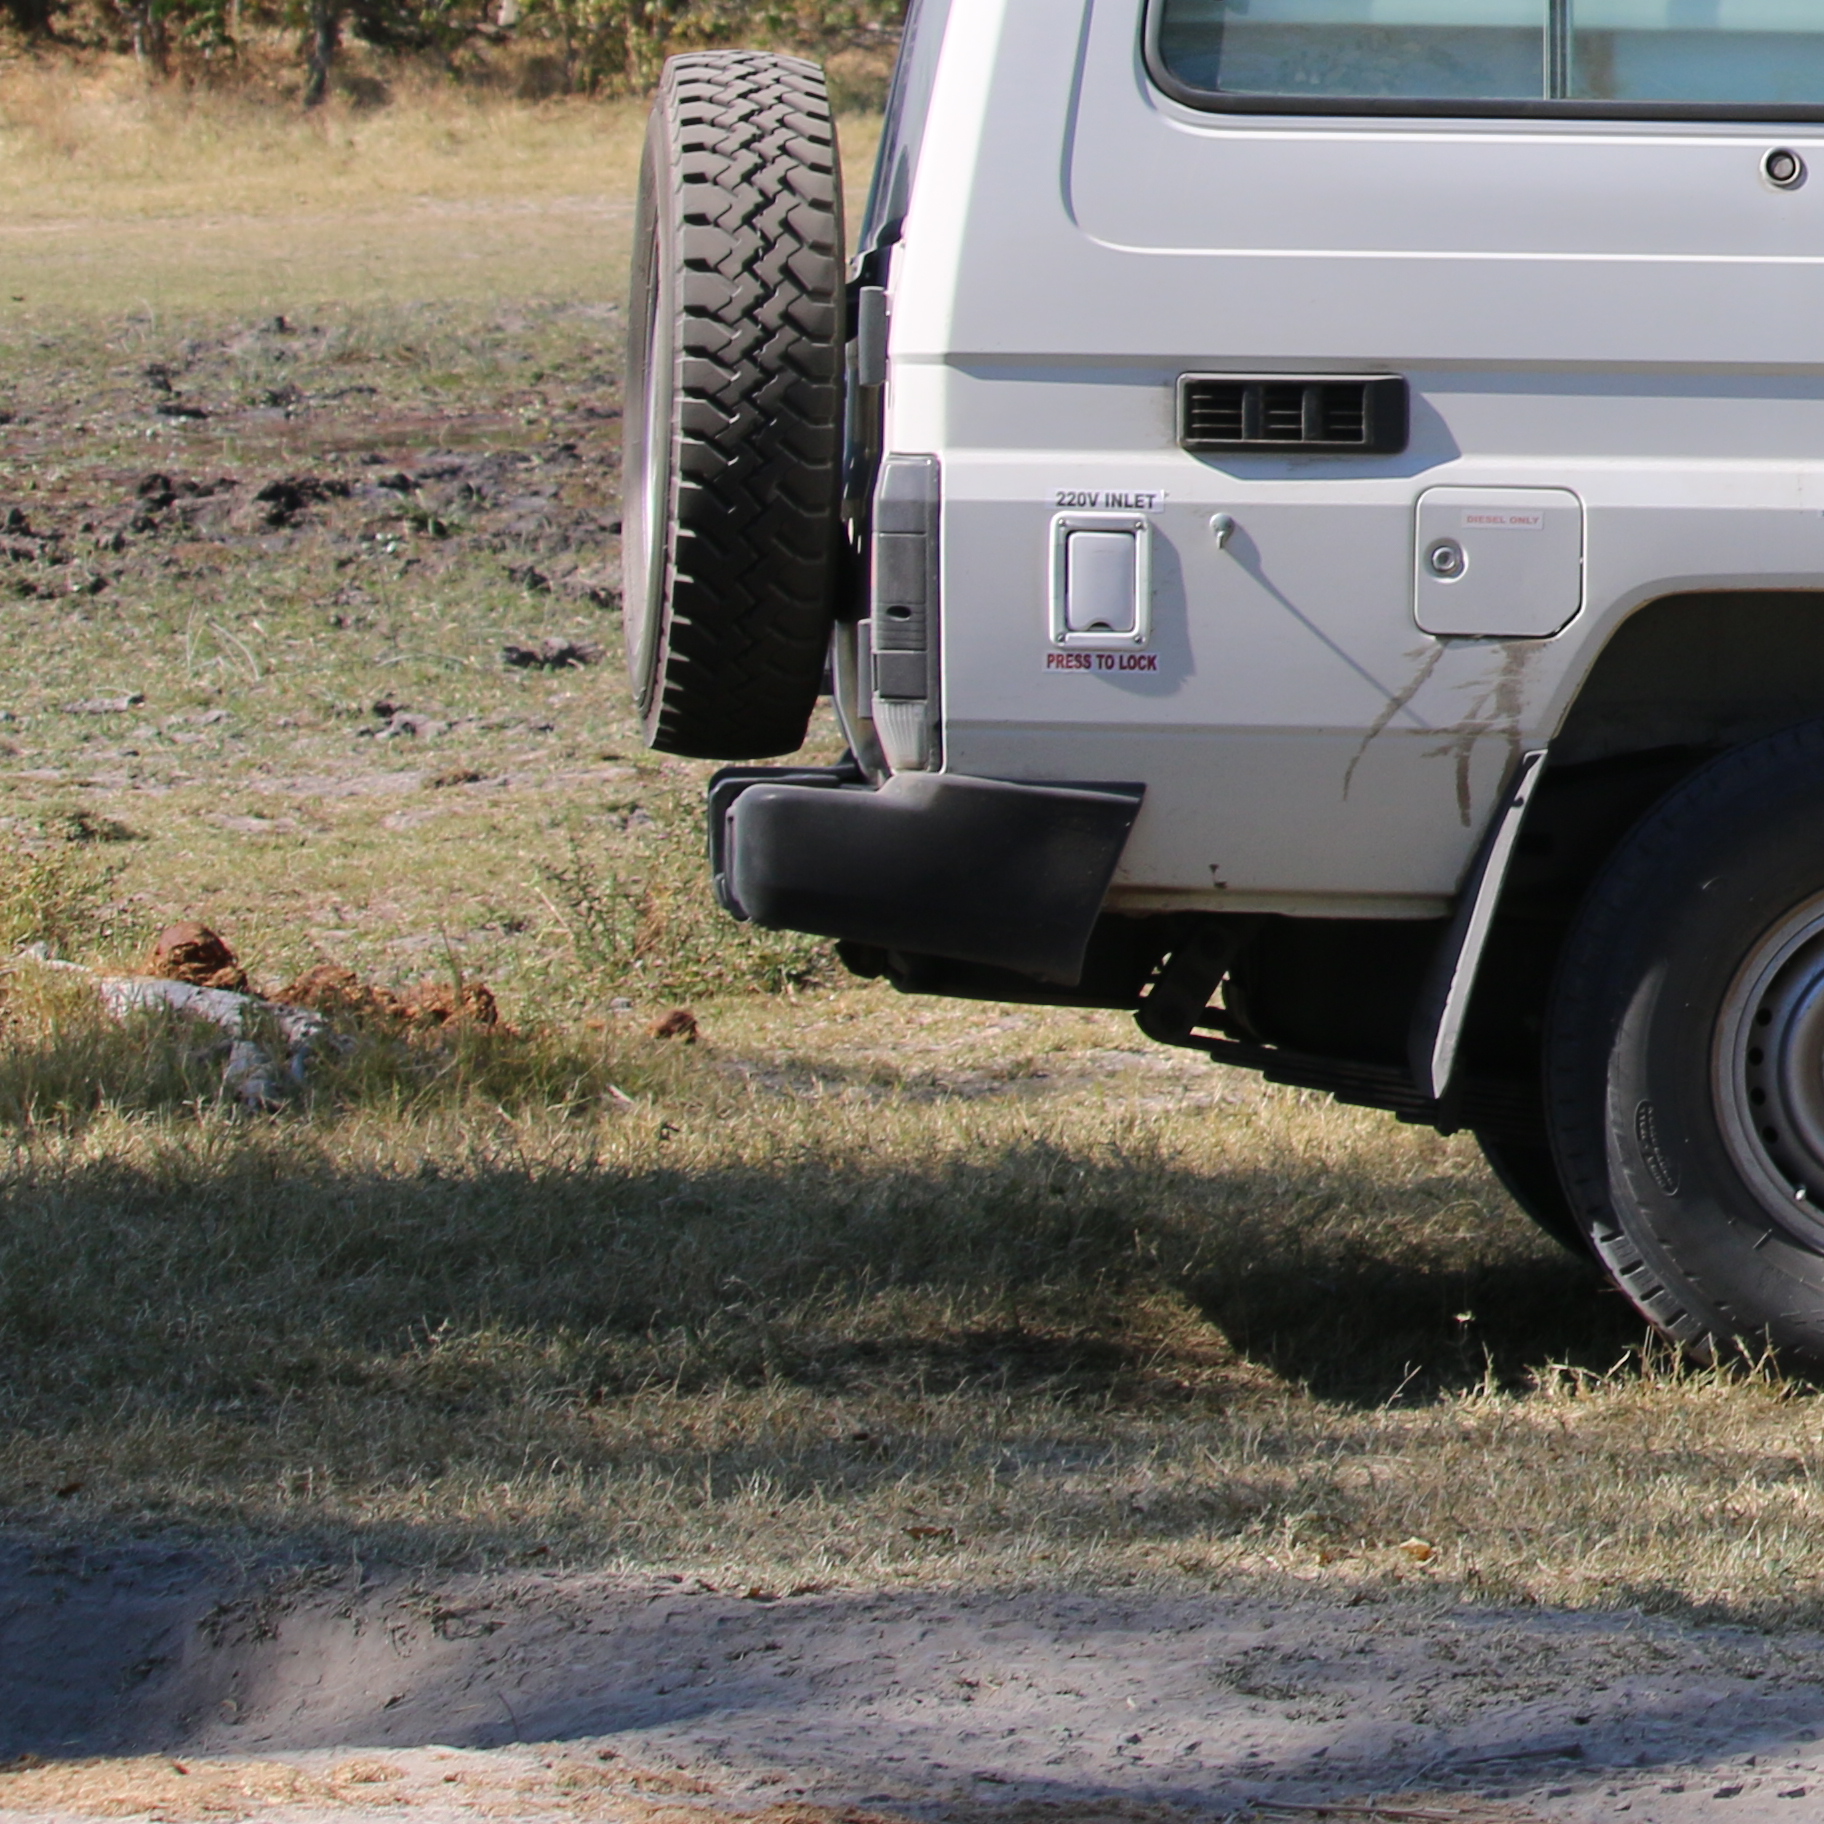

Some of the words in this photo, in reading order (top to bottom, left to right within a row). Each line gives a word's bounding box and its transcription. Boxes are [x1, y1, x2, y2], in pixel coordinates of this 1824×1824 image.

[1055, 491, 1100, 507] 220V
[1104, 492, 1157, 509] INLET
[1466, 514, 1506, 524] DIESEL
[1509, 516, 1540, 525] ONLY
[1046, 653, 1092, 669] PRESS
[1095, 654, 1115, 670] TO
[1118, 654, 1158, 671] LOCK
